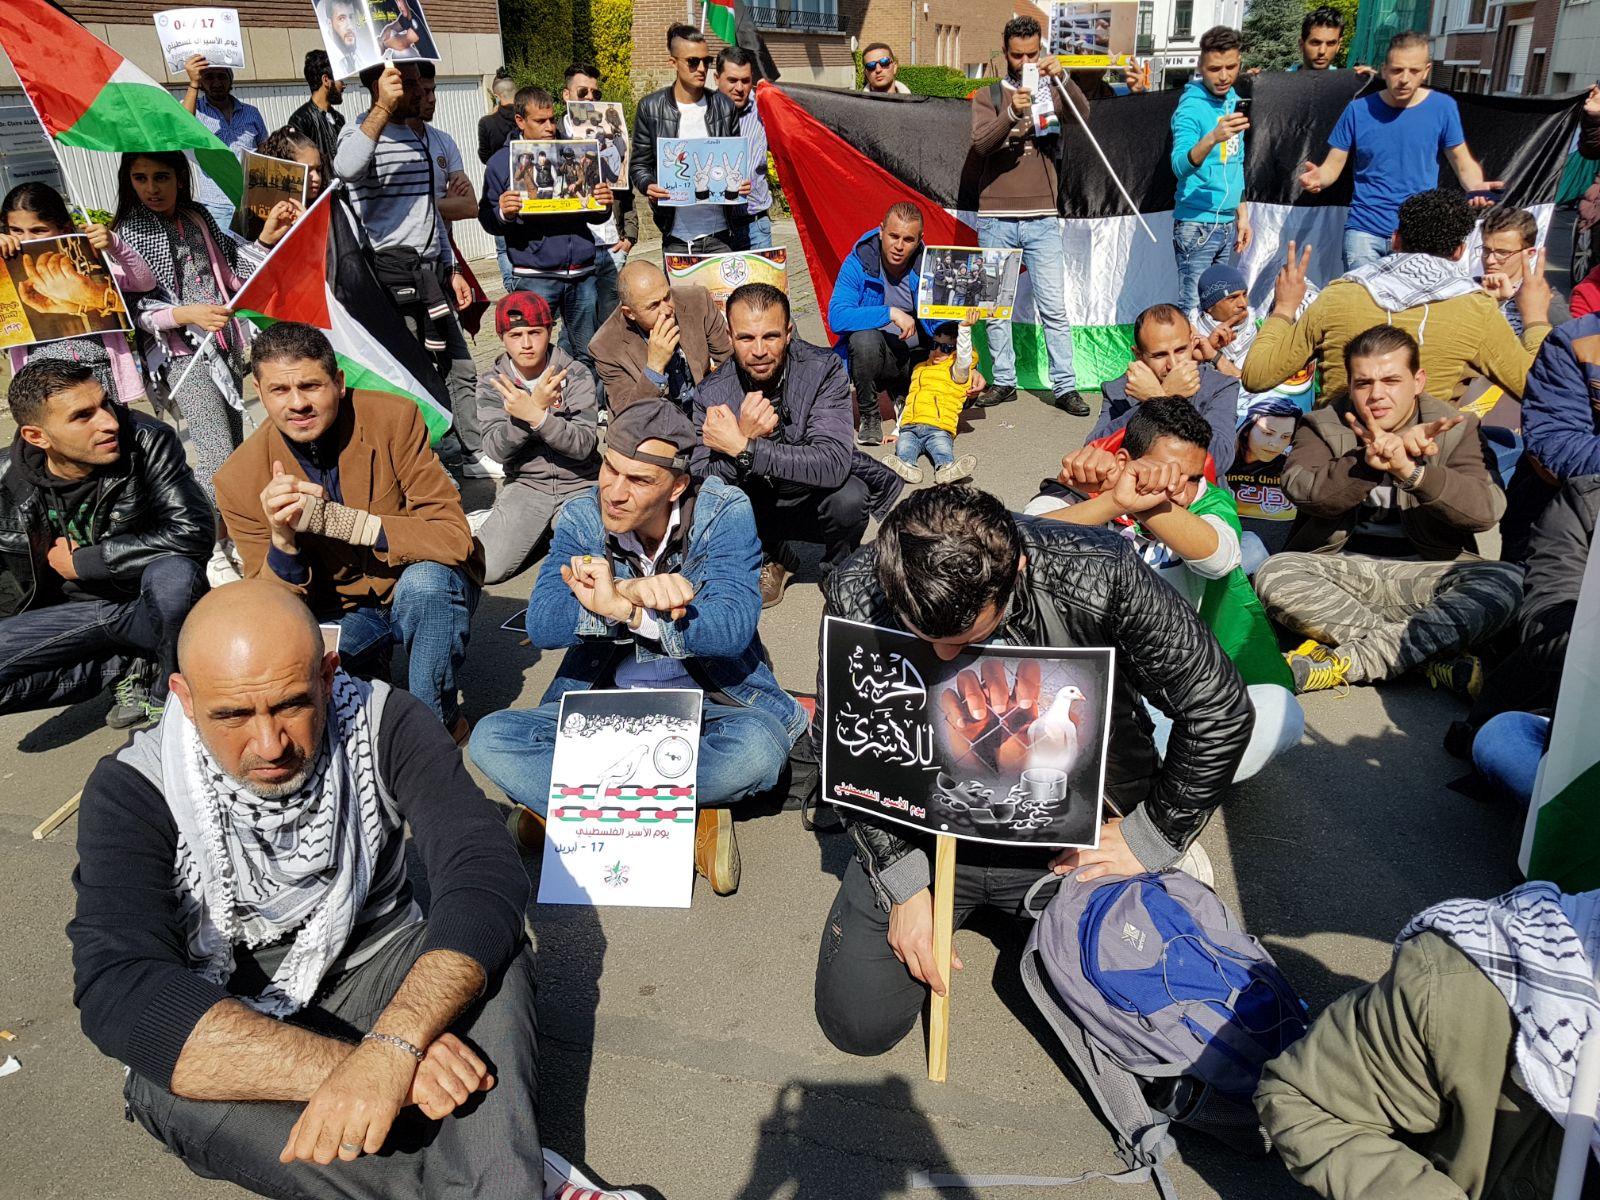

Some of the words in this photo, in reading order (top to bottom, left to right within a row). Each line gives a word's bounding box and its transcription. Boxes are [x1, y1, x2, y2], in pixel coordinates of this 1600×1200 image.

[201, 18, 215, 28] 17
[225, 39, 238, 47] يوم
[834, 782, 880, 802] الفلسطيني
[881, 796, 909, 811] الأسير
[910, 804, 926, 819] يوم
[575, 827, 624, 838] الفلسطيني
[626, 825, 651, 838] الأسير
[652, 828, 670, 839] يوم
[591, 842, 604, 852] 17
